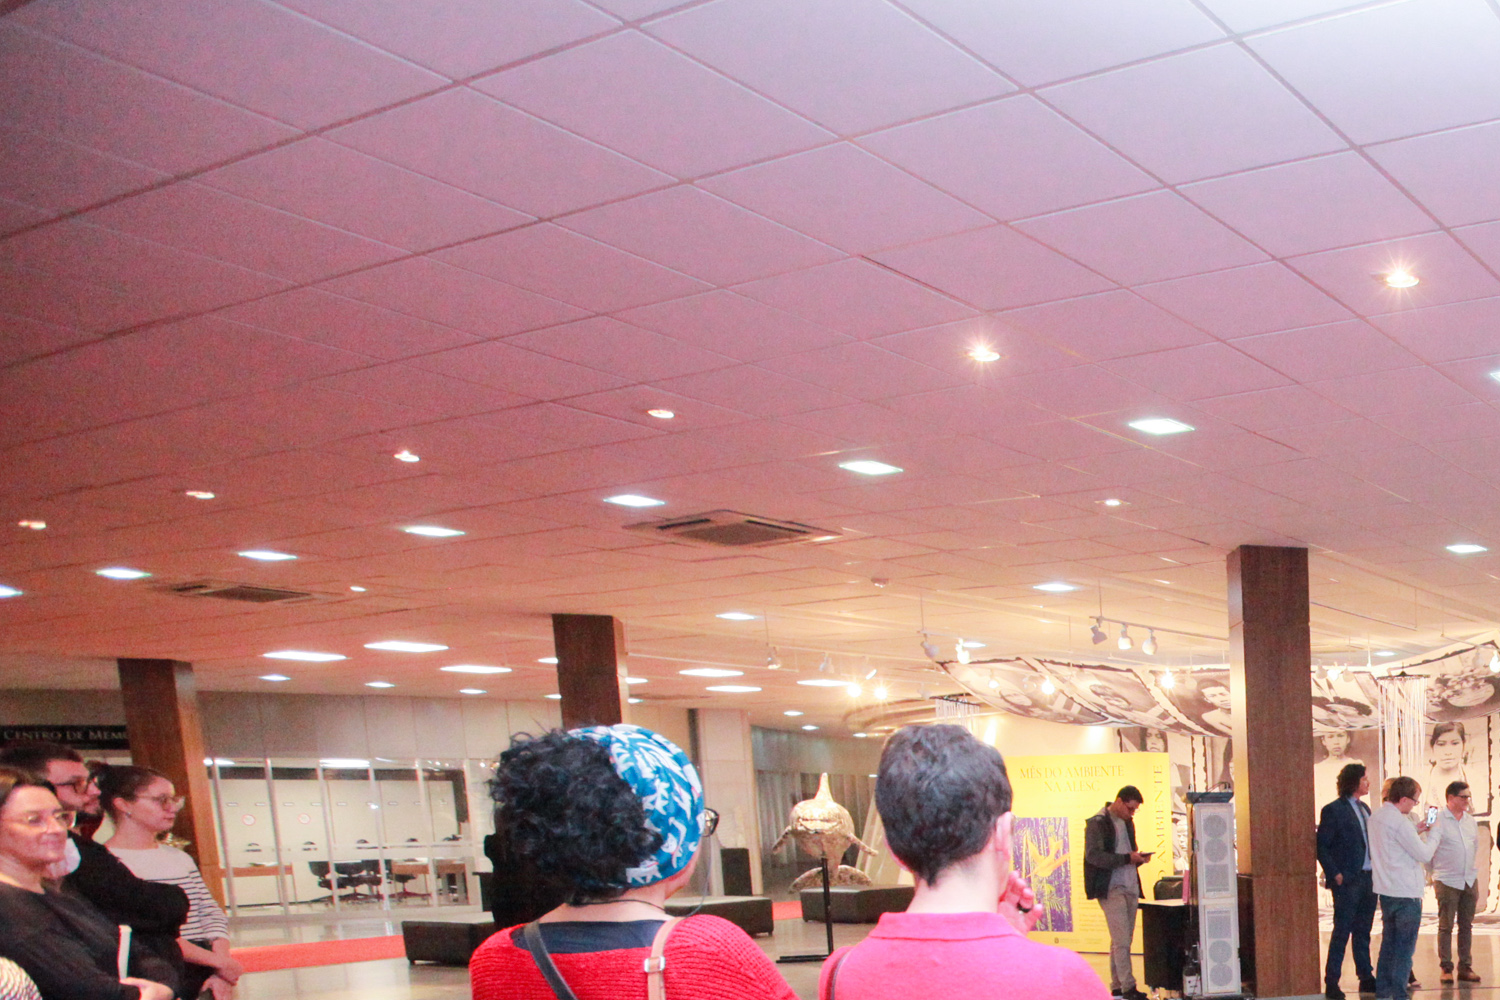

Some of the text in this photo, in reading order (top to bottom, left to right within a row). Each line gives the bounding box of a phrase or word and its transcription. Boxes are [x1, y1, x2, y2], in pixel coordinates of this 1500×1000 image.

[1045, 766, 1062, 778] DO
[1064, 765, 1124, 778] AMBIENTE
[1044, 780, 1101, 793] NA ALESC
[1153, 765, 1167, 864] AMBIENTE
